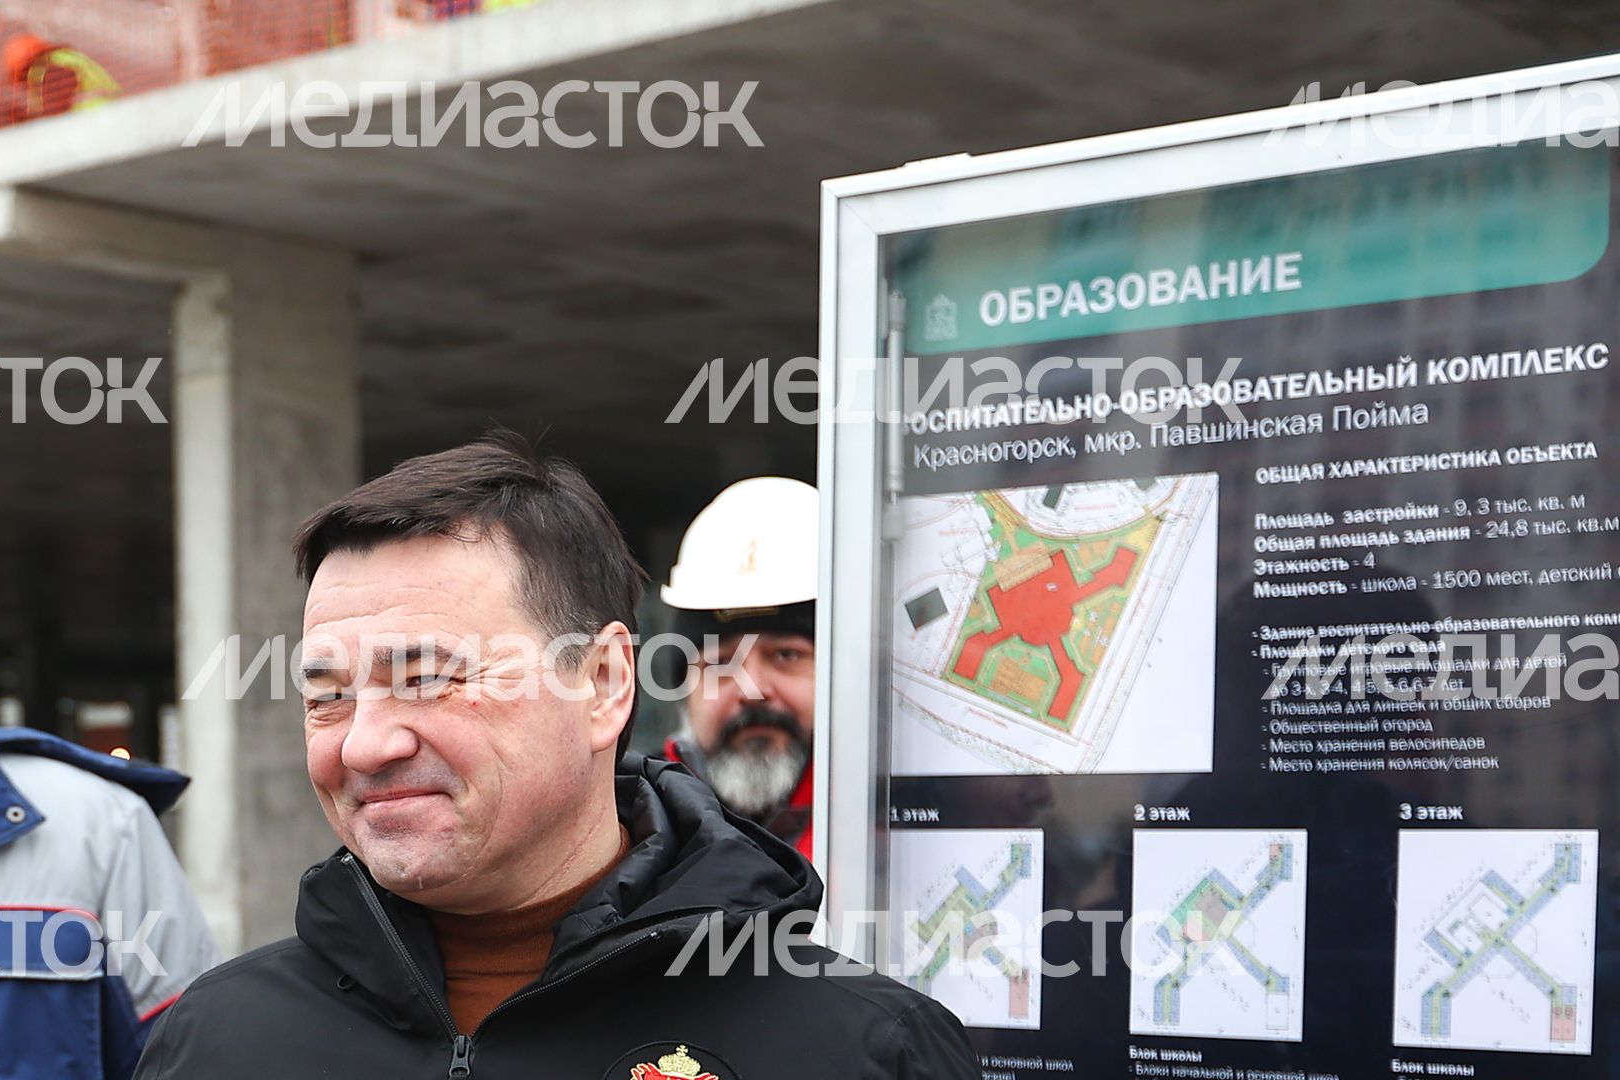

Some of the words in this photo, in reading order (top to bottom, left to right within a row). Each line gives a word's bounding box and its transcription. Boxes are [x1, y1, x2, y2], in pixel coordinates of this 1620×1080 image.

[979, 252, 1303, 328] ОБРАЗОВАНИЕ
[1427, 342, 1609, 386] КОМПЛЕКС
[913, 434, 1077, 472] Красногорск,
[1084, 428, 1141, 461] мкр.
[1150, 412, 1323, 448] Павшинская
[1332, 400, 1429, 432] Пойма
[1255, 463, 1325, 485] ОБЩАЯ
[1329, 448, 1502, 479] ХАРАКТЕРИСТИКА
[1506, 441, 1598, 465] ОБЪЕКТА
[1254, 511, 1335, 530] Площадь
[1342, 500, 1440, 525] застройки
[1495, 497, 1532, 514] тыс.
[1254, 534, 1315, 553] Общая
[1319, 530, 1400, 550] площадь
[1403, 525, 1471, 545] здания
[1484, 518, 1529, 539] 24,8
[1532, 519, 1571, 536] тыс.
[1253, 556, 1350, 576] Этажность
[1363, 551, 1376, 569] 4
[1253, 579, 1348, 599] Мощность
[1361, 575, 1417, 593] школа
[1432, 569, 1481, 589] 1500
[1538, 562, 1612, 585] детский
[1260, 624, 1315, 641] Здание
[1318, 614, 1580, 638] воспитательно-образовательного
[1260, 643, 1336, 660] Площадки
[1339, 639, 1406, 657] детского
[1409, 638, 1446, 655] сада
[1270, 700, 1343, 717] Площадка
[1345, 700, 1371, 715] для
[1430, 699, 1439, 711] и
[1443, 694, 1492, 712] общих
[1269, 716, 1379, 735] Общественный
[1383, 718, 1433, 734] огород
[1269, 737, 1314, 754] Место
[1316, 737, 1385, 756] хранения
[1389, 735, 1485, 752] велосипедов
[1269, 756, 1313, 773] Место
[1316, 756, 1385, 774] хранения
[890, 806, 900, 822] 1
[903, 807, 940, 823] этаж
[1133, 804, 1146, 821] 2
[1149, 805, 1191, 822] этаж
[1399, 803, 1413, 820] 3
[1416, 803, 1464, 821] этаж
[1128, 1045, 1158, 1060] Блок
[1160, 1048, 1203, 1063] школы
[1135, 1060, 1170, 1077] Блоки
[1236, 1067, 1244, 1080] и
[1391, 1058, 1424, 1074] Блок
[1426, 1062, 1475, 1077] школы
